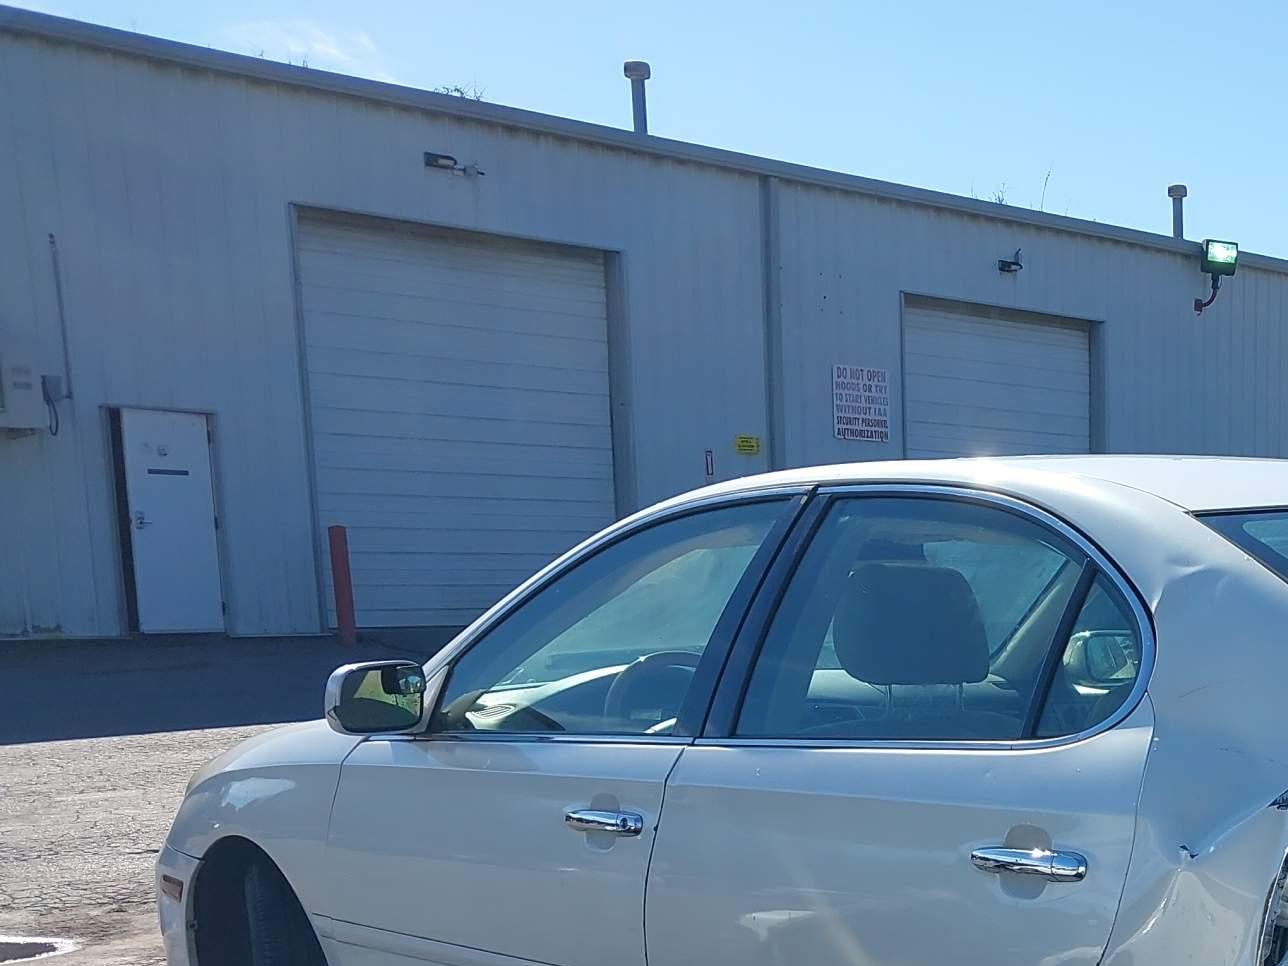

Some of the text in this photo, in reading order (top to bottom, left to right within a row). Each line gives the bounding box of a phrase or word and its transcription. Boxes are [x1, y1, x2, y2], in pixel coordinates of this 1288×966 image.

[836, 366, 886, 383] DO NOT OPEN
[835, 380, 887, 394] HOODS OR TRY
[835, 392, 888, 406] TO START VEHICLES
[835, 404, 887, 417] WITHOUT IAA
[836, 415, 888, 428] SECURITY PERSONNEL
[836, 427, 888, 440] AUTHORIZATION
